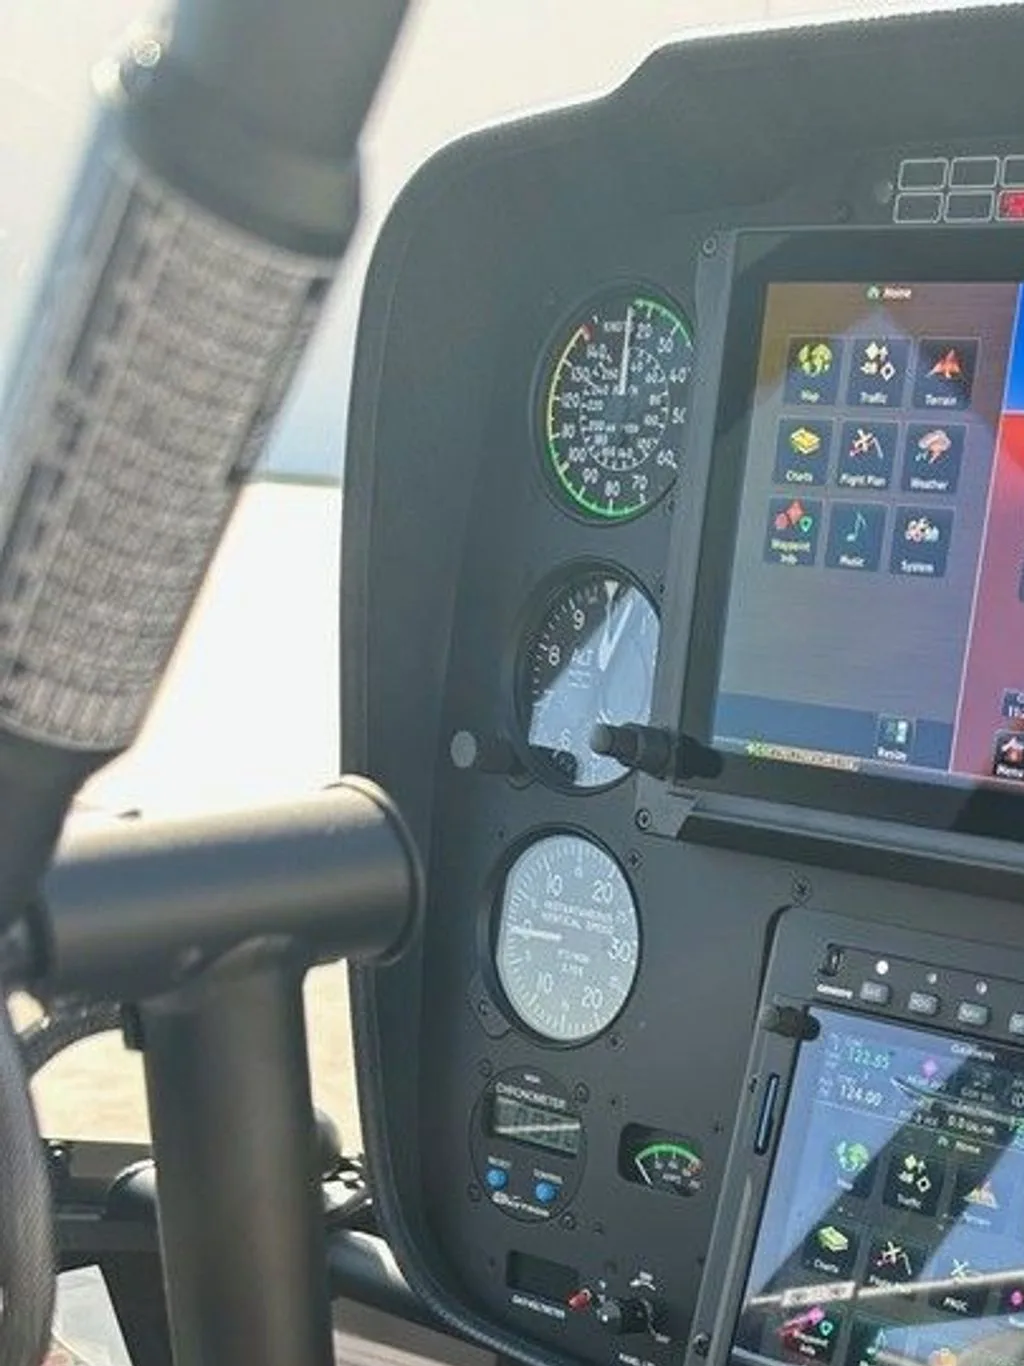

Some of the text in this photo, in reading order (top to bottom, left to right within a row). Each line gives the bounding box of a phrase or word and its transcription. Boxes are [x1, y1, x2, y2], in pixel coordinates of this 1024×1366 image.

[925, 394, 957, 406] Terrain
[572, 608, 586, 631] 9
[549, 644, 561, 667] 8
[547, 874, 563, 897] 10
[592, 879, 614, 903] 20
[608, 937, 631, 962] 30
[535, 971, 554, 994] 10
[581, 986, 604, 1009] 20
